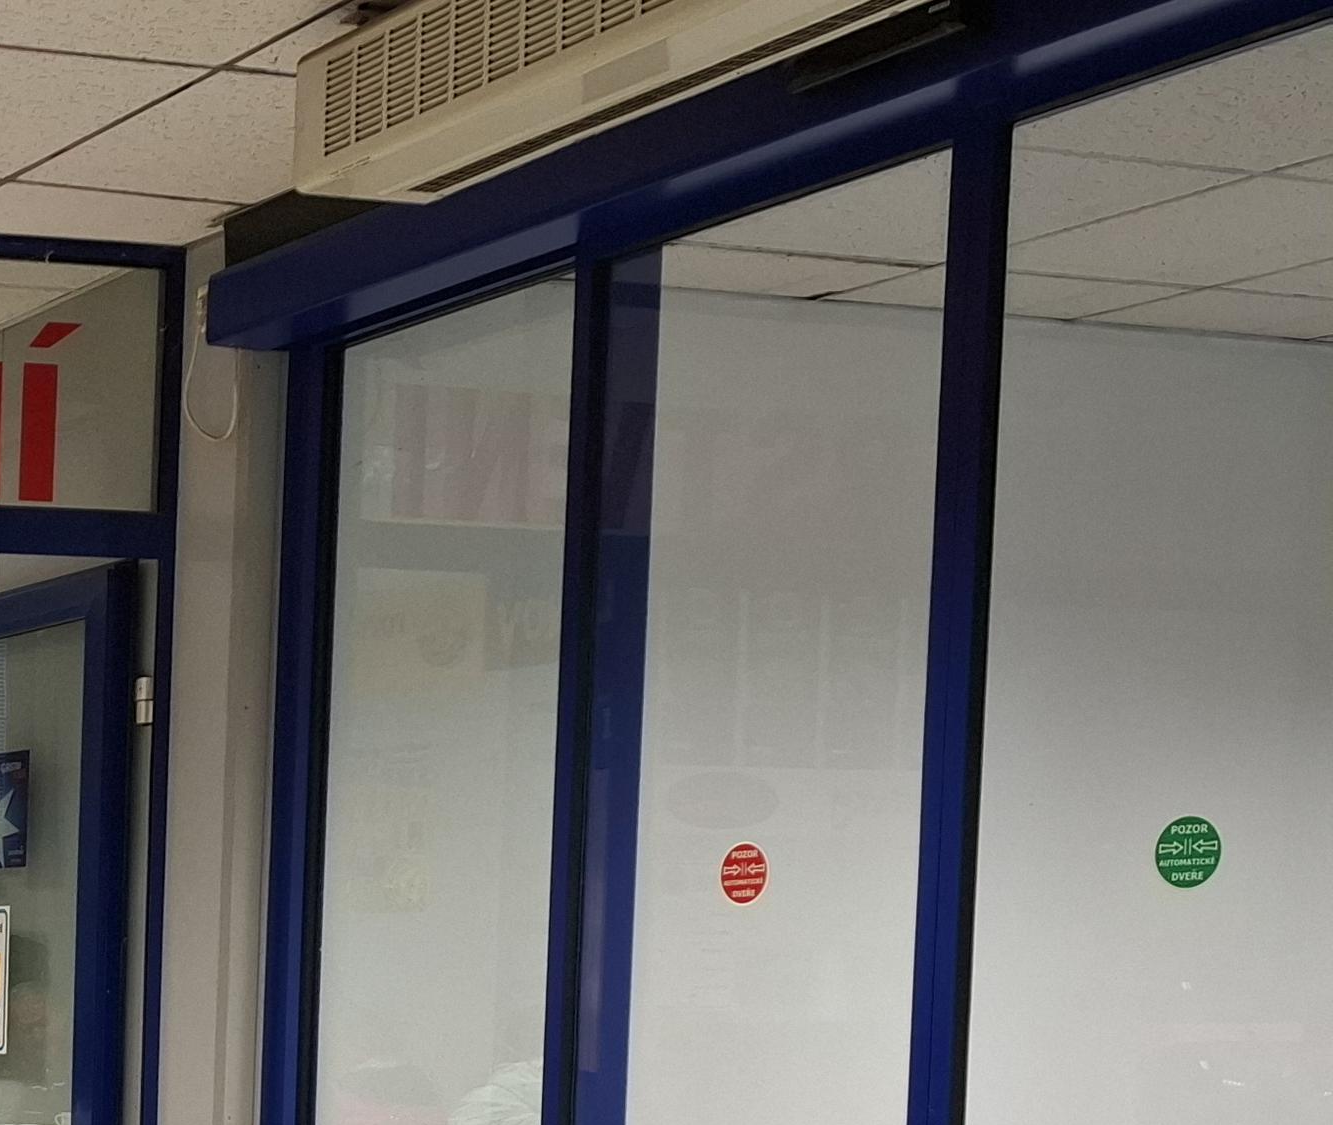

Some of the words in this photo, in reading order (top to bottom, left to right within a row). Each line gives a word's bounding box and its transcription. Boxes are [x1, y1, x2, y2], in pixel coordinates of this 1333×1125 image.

[1171, 823, 1209, 835] POZOR
[732, 849, 759, 859] POZOR
[1159, 856, 1215, 867] AUTOMATICKÉ
[1171, 868, 1204, 881] DVEŘE
